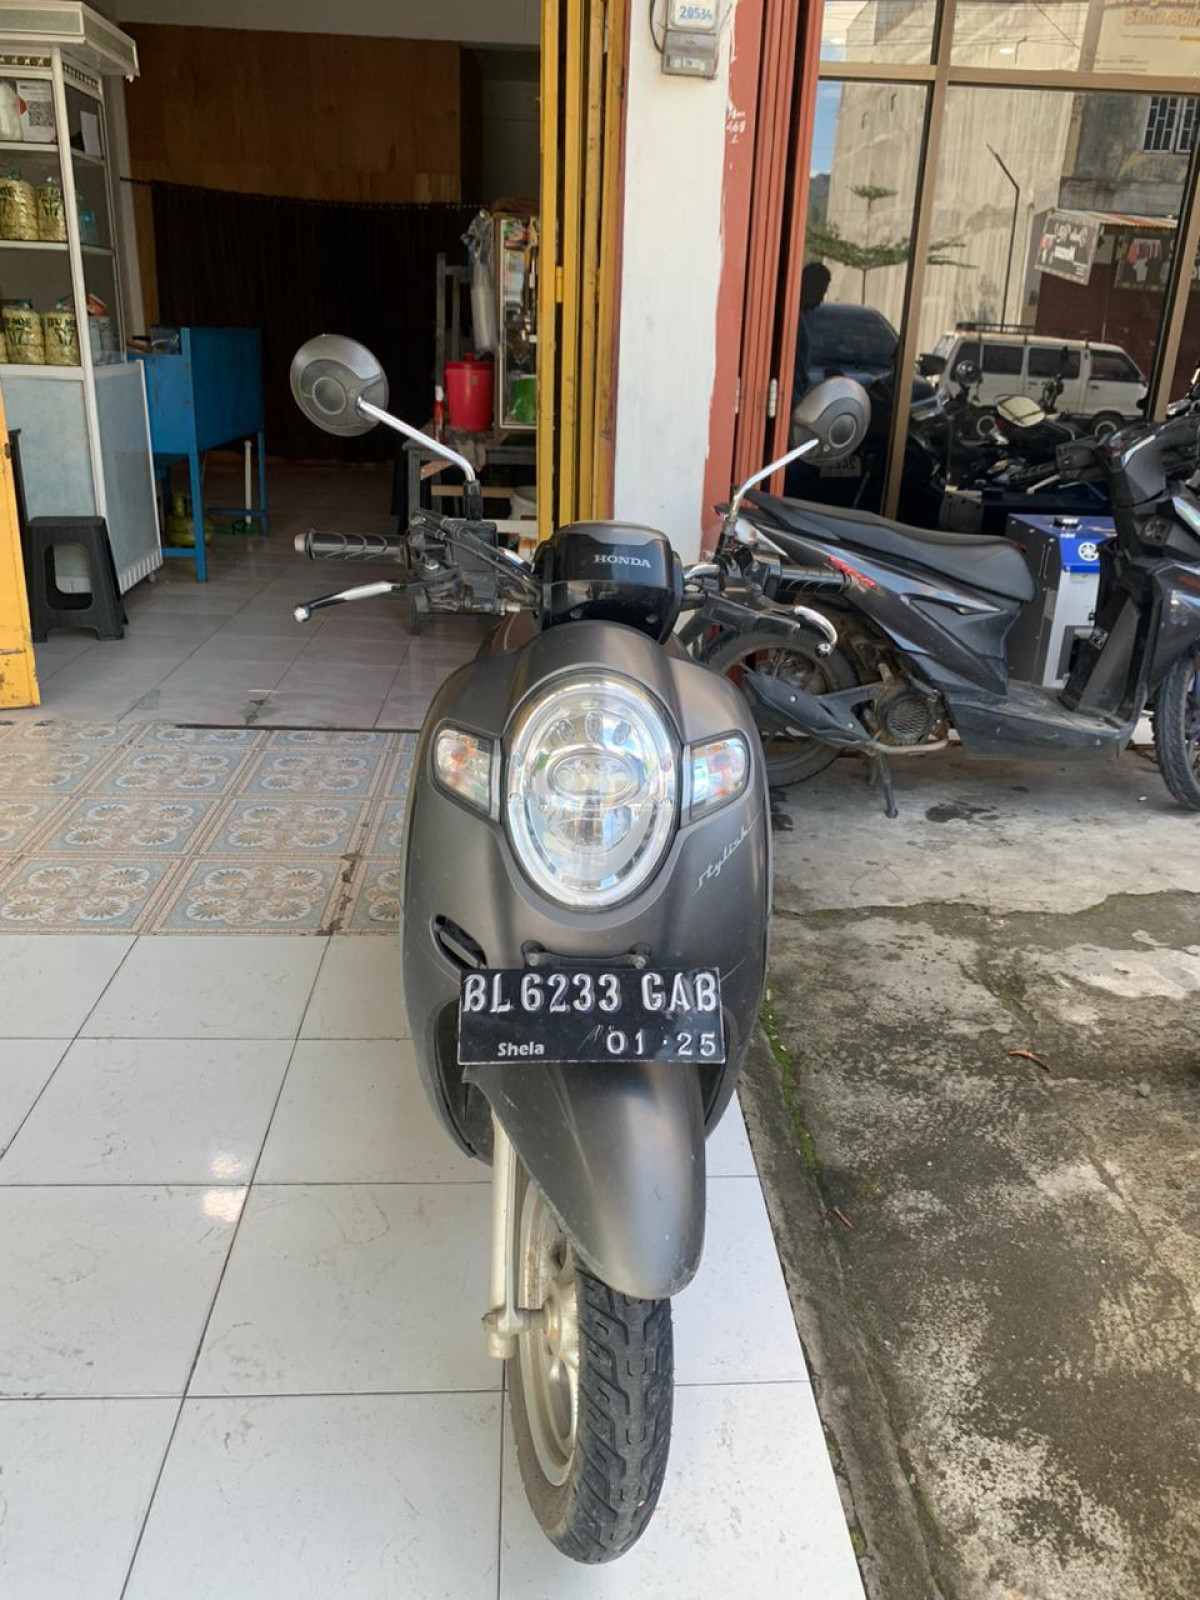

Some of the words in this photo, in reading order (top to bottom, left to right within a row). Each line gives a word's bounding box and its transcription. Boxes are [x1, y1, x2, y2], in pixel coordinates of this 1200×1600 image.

[680, 5, 713, 20] 20534
[594, 554, 652, 569] HONDA
[462, 973, 516, 1013] BL
[520, 973, 622, 1012] 6233
[641, 972, 717, 1012] GAB
[497, 1042, 545, 1057] Shela
